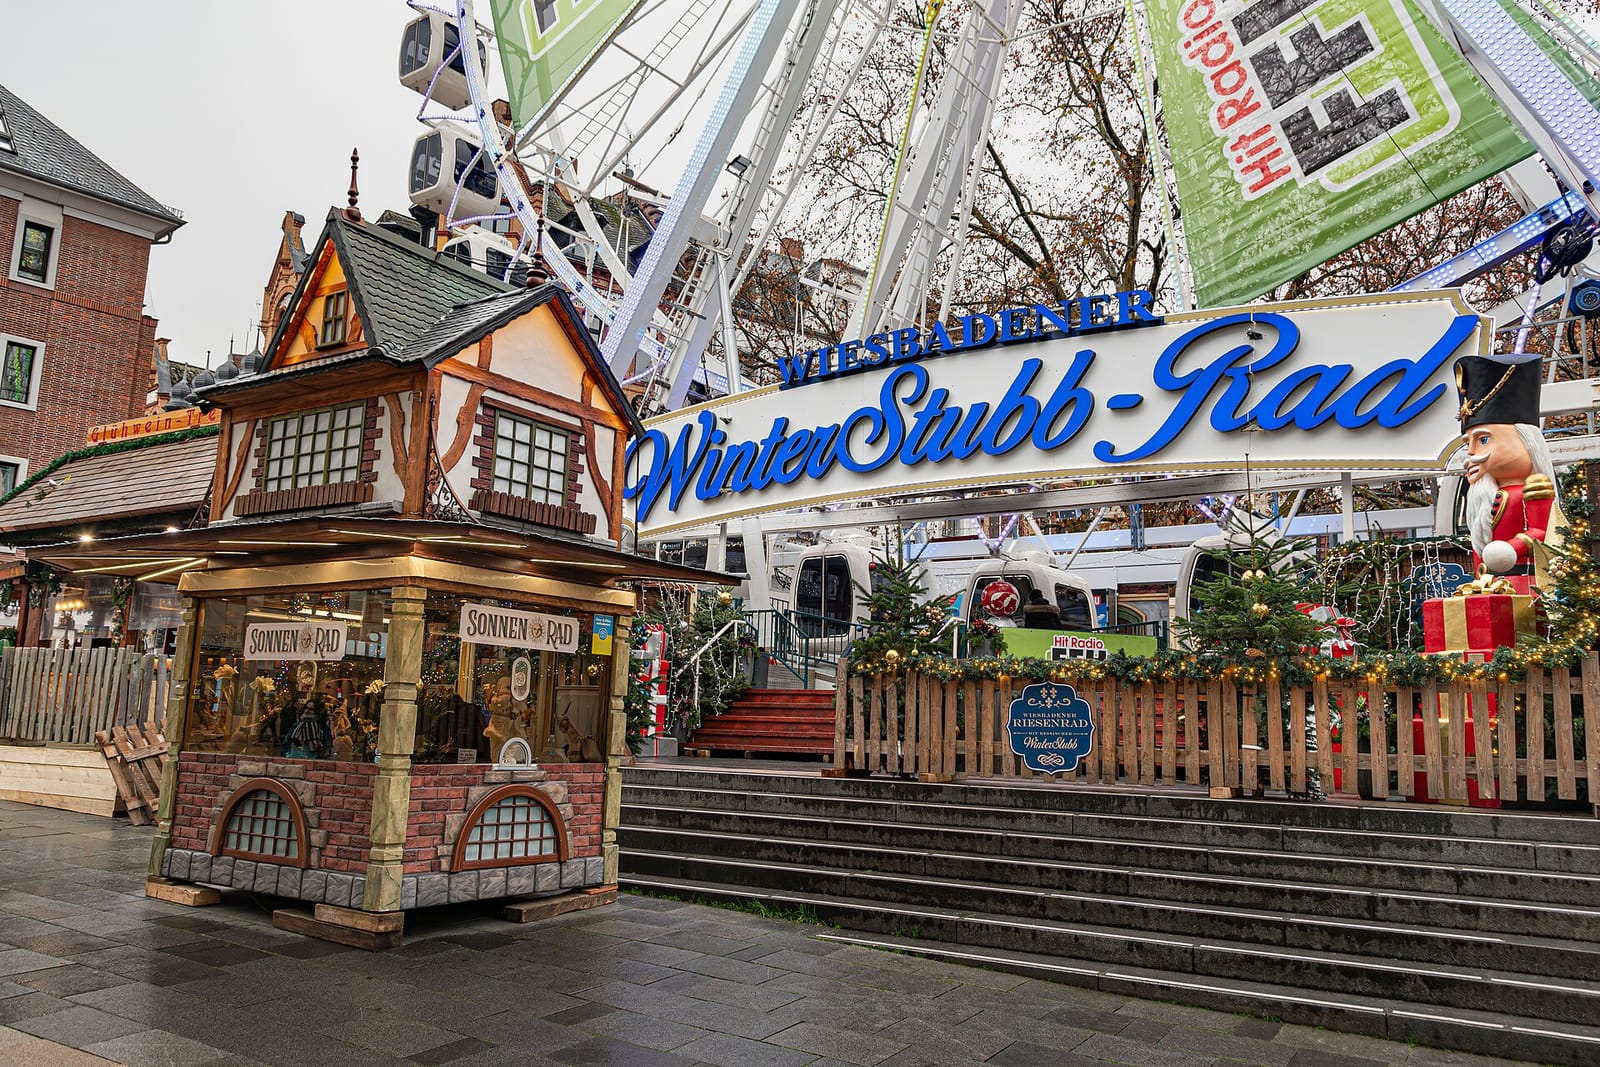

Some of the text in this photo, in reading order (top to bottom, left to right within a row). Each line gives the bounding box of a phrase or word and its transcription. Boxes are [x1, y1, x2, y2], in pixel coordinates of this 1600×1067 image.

[1183, 0, 1292, 194] Hit Radio
[775, 288, 1159, 386] WIESBADENER
[250, 627, 341, 659] SONNEN RAD
[467, 609, 573, 649] SONNEN RAD
[1054, 636, 1104, 649] Hit Radio
[1013, 718, 1089, 728] RIESENRAD
[1023, 736, 1078, 750] WinterStubb
